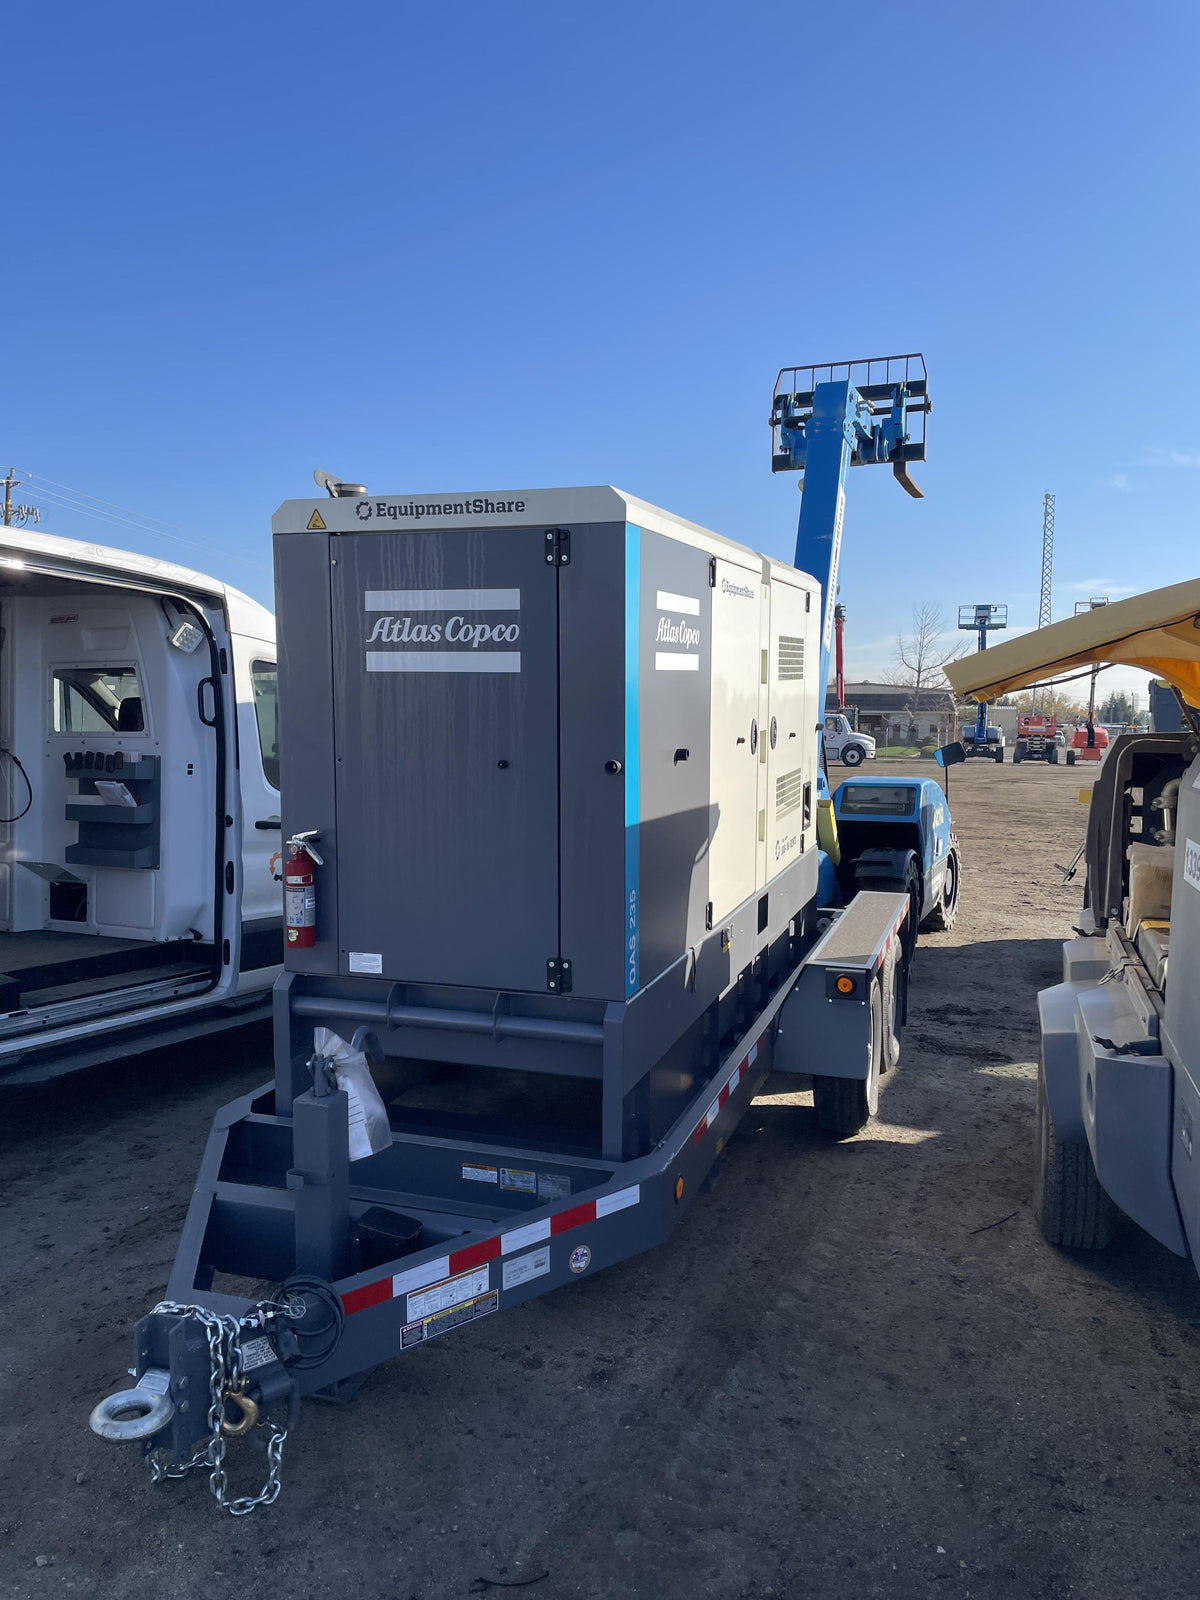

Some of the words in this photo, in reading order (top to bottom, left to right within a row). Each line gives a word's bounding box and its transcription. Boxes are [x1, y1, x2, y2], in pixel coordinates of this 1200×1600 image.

[375, 499, 526, 519] EquipmentShare
[366, 616, 442, 643] Atlas
[444, 616, 520, 648] Copco
[656, 617, 679, 643] Atlas
[679, 620, 700, 650] Copco
